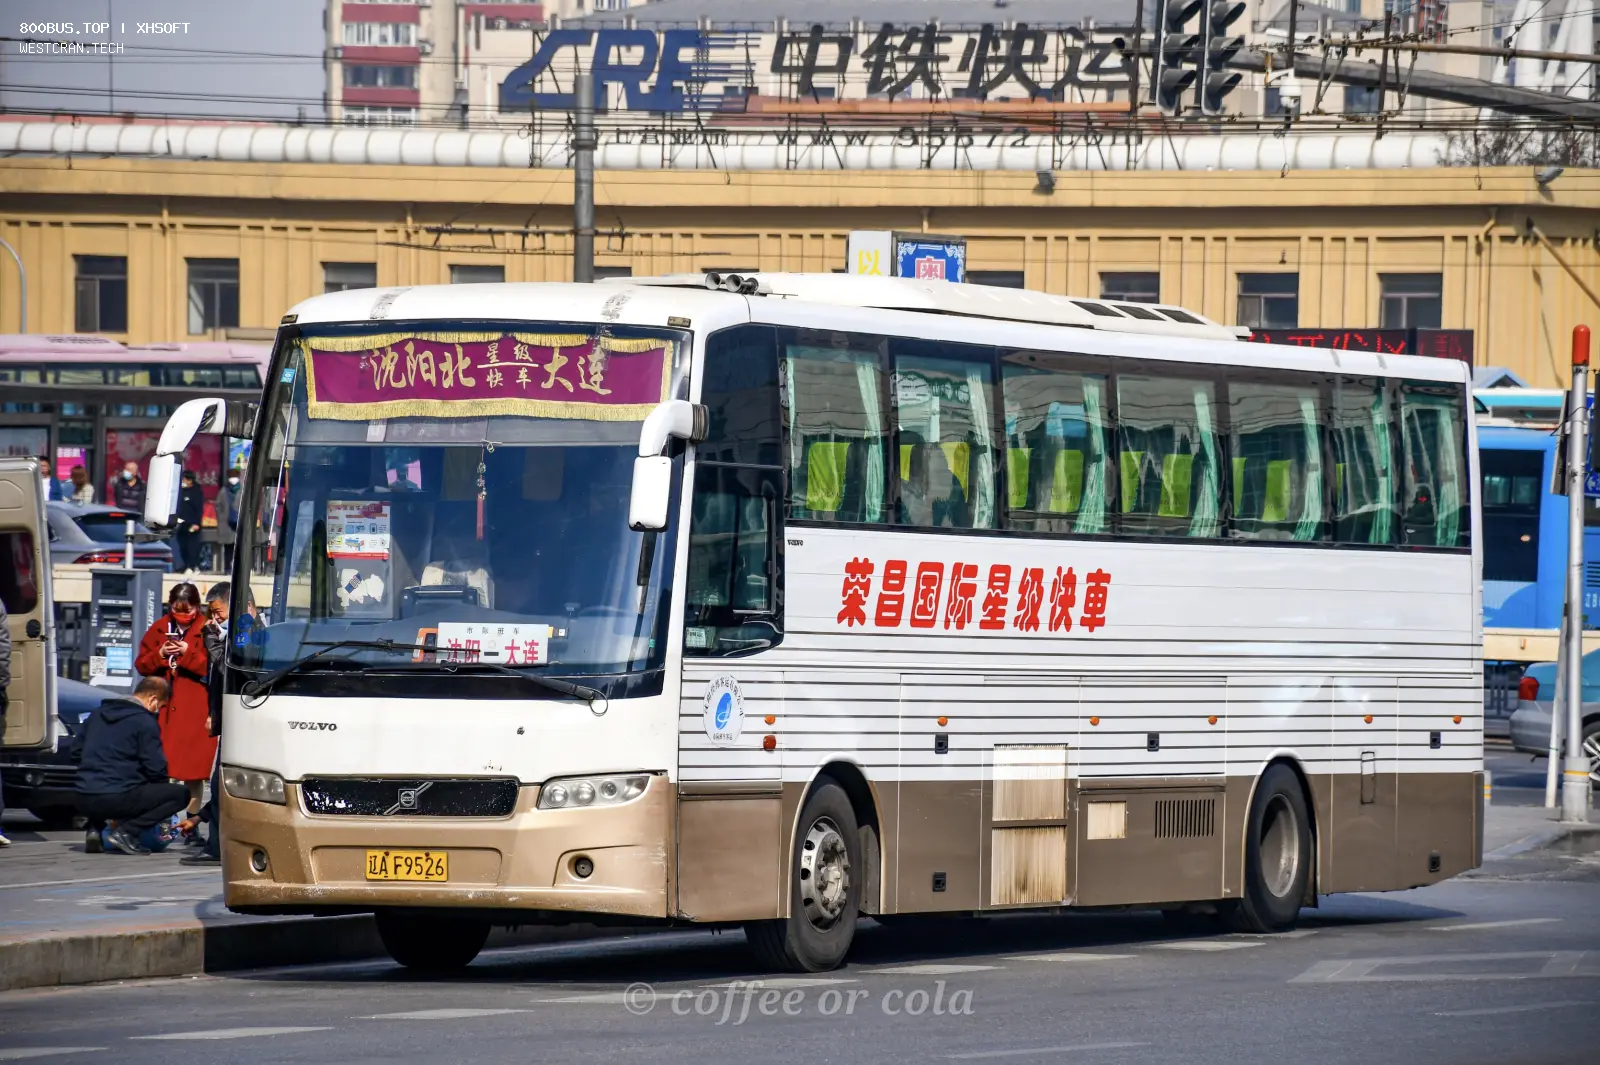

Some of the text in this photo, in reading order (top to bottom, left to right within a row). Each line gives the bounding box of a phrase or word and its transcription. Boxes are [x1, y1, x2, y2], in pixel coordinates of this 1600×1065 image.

[771, 23, 1146, 97] 中铁快运
[370, 338, 476, 391] 沈阳北
[486, 342, 533, 363] 星级
[486, 367, 532, 390] 快车
[288, 720, 338, 732] VOLVO
